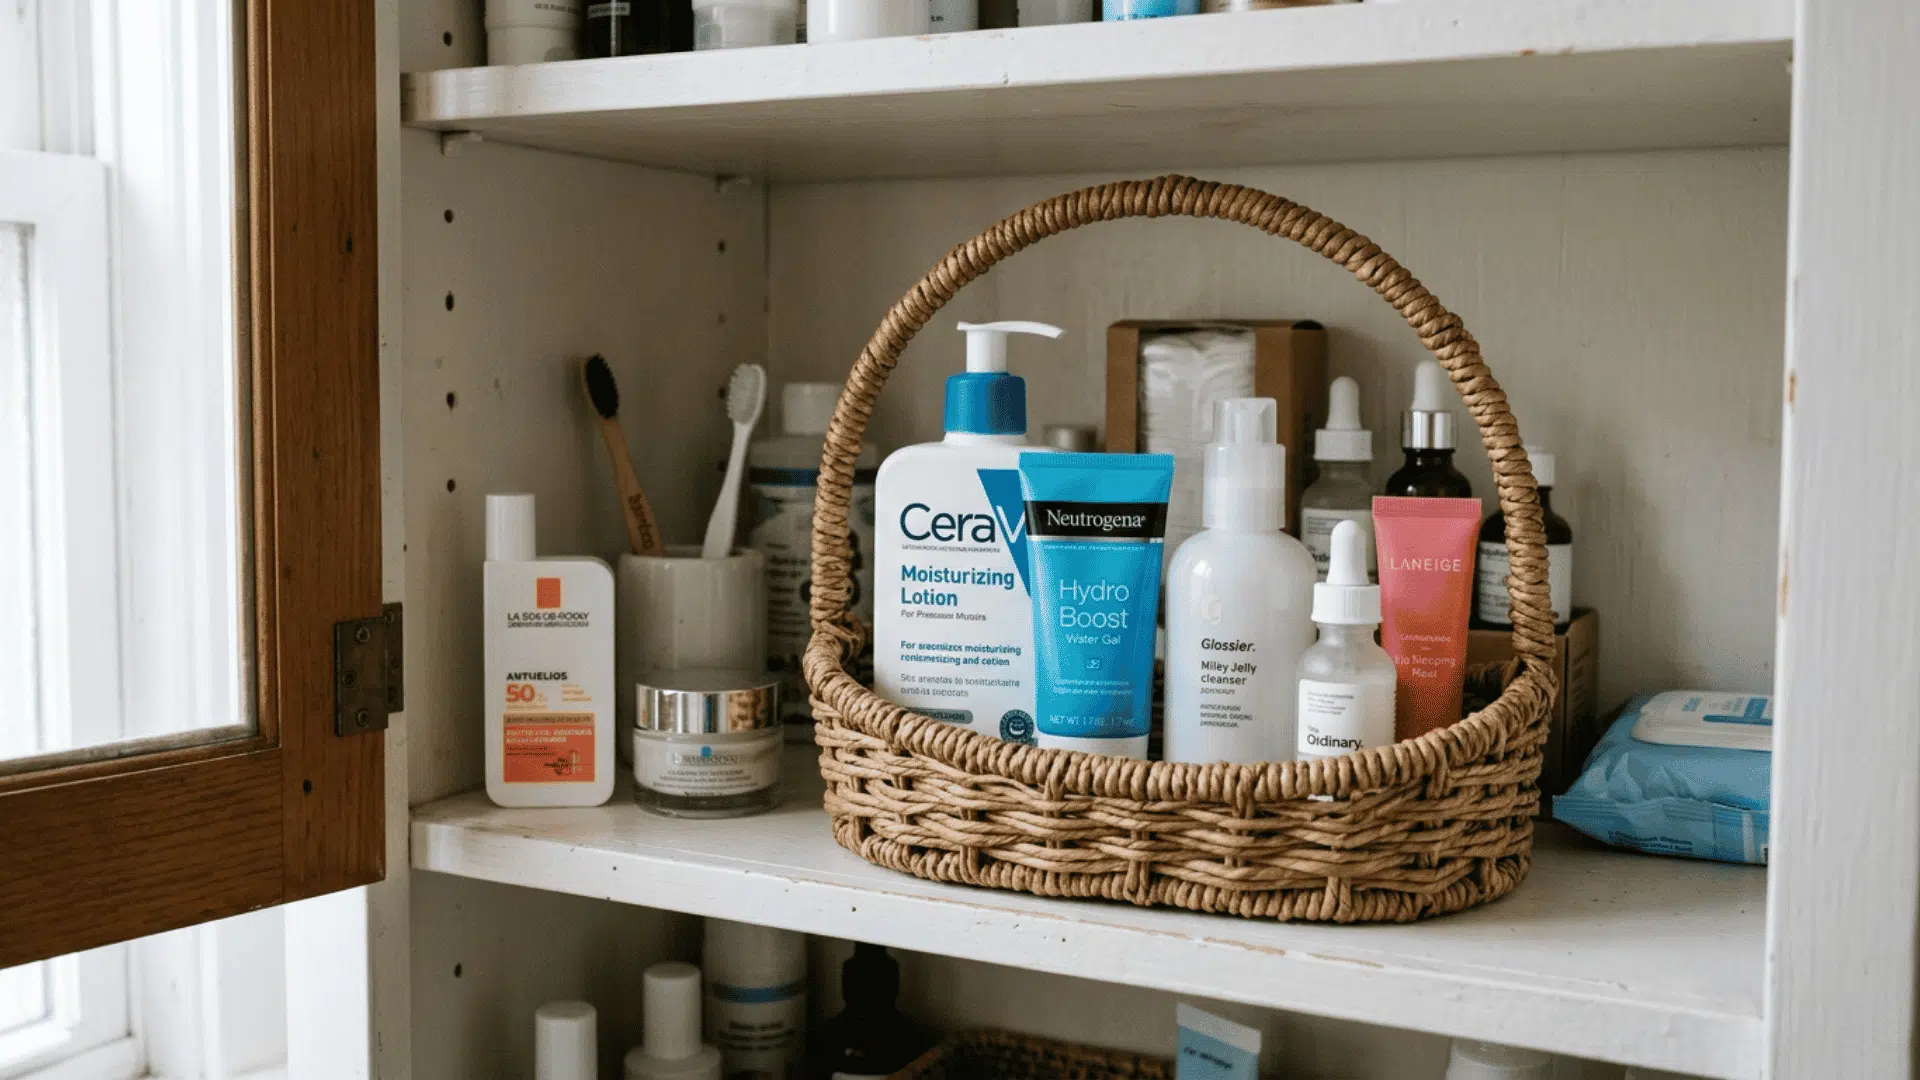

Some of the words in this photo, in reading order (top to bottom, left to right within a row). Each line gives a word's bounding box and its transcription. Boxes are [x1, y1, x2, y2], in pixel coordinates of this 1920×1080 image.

[1390, 557, 1461, 572] LANEIGE
[901, 564, 1015, 590] Moisturizing
[901, 587, 958, 607] Lotion
[1059, 578, 1130, 605] Hydro
[1060, 605, 1130, 629] Boost
[901, 640, 916, 650] For
[1066, 633, 1098, 645] Water
[1201, 637, 1256, 652] Glossier.
[963, 656, 980, 665] and
[1231, 662, 1258, 675] Jelly
[1201, 673, 1248, 686] cleanser
